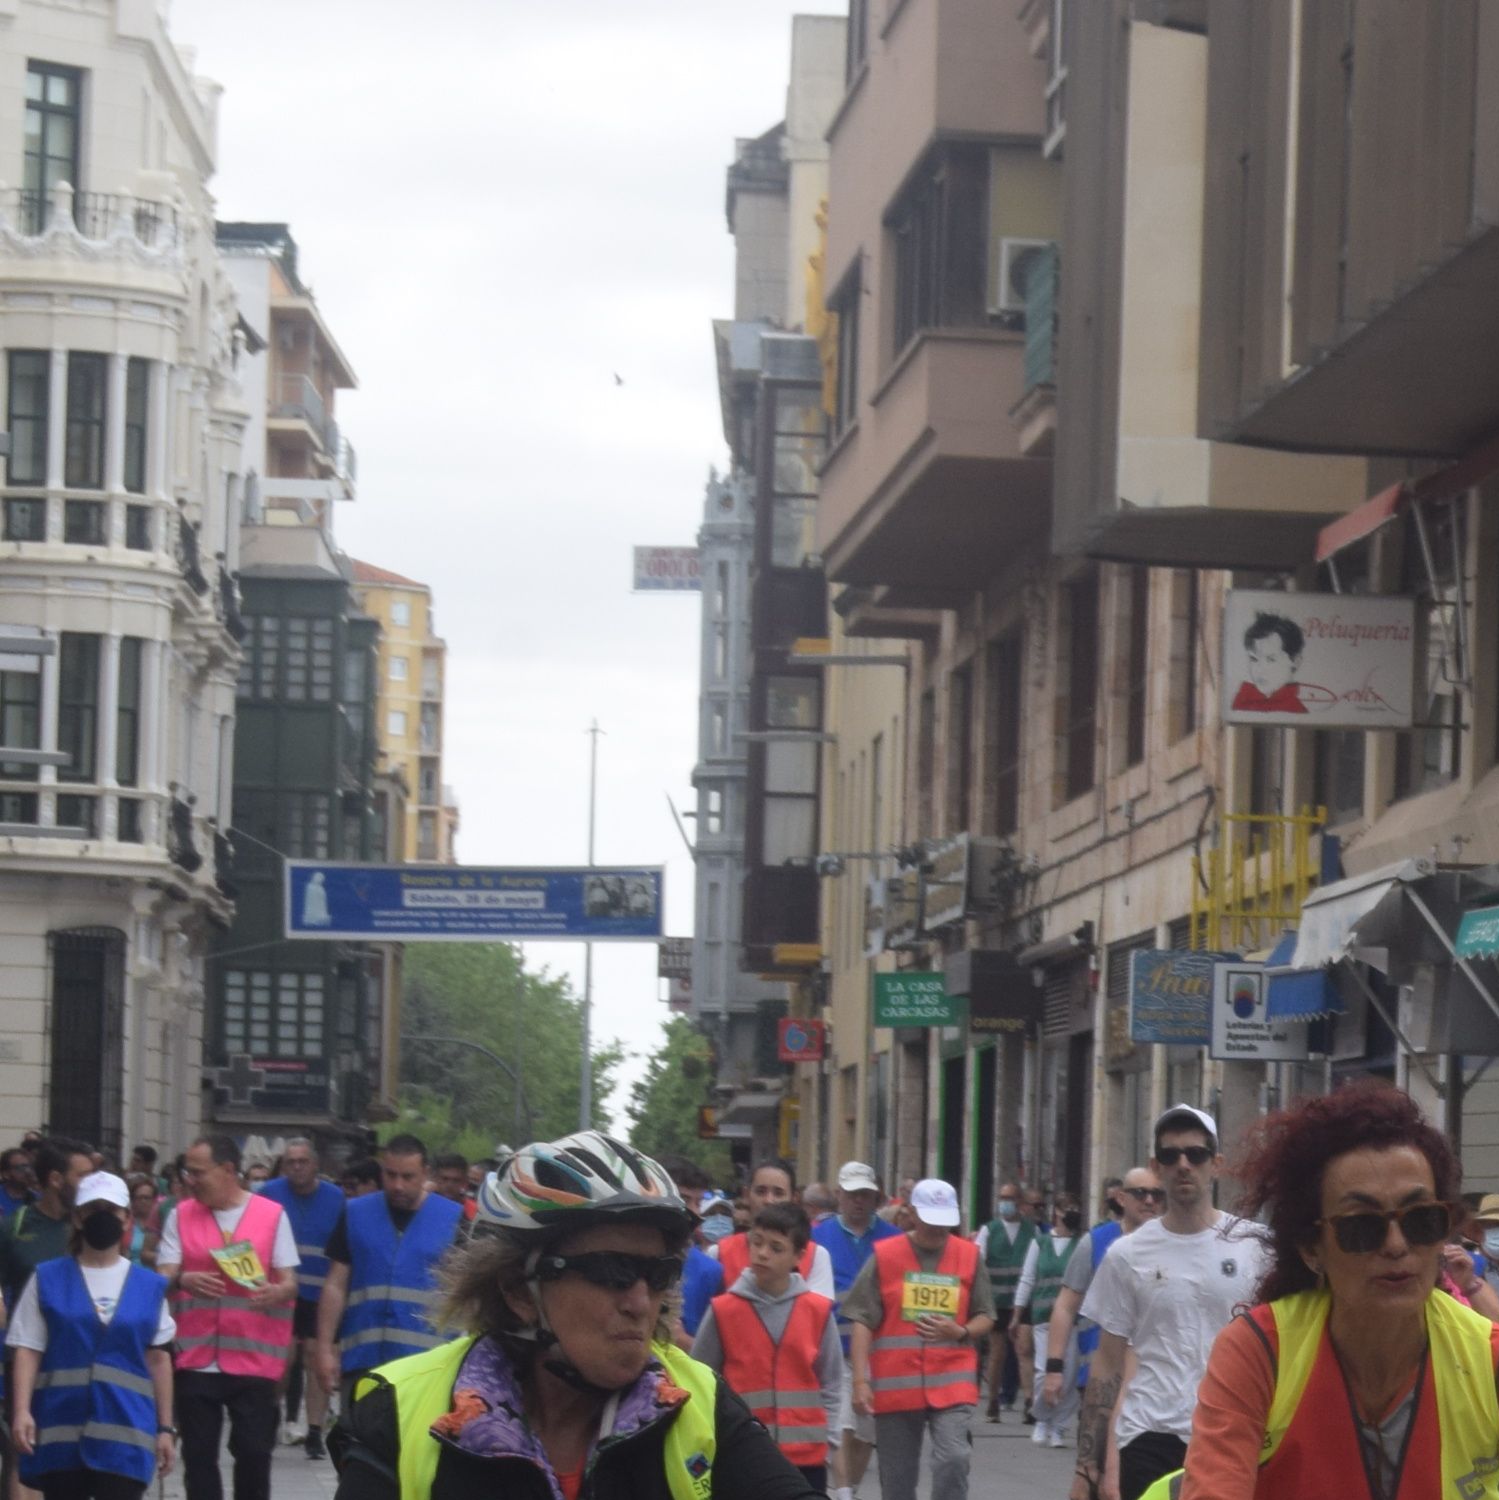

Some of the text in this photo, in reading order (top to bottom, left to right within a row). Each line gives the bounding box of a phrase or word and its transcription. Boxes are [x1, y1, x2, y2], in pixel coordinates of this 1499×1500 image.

[886, 982, 944, 993] LA CASA
[890, 994, 940, 1005] DE LAS
[881, 1005, 950, 1018] CARCASAS
[972, 1017, 1026, 1033] orange
[1225, 1042, 1259, 1052] Estado
[912, 1286, 950, 1309] 1912
